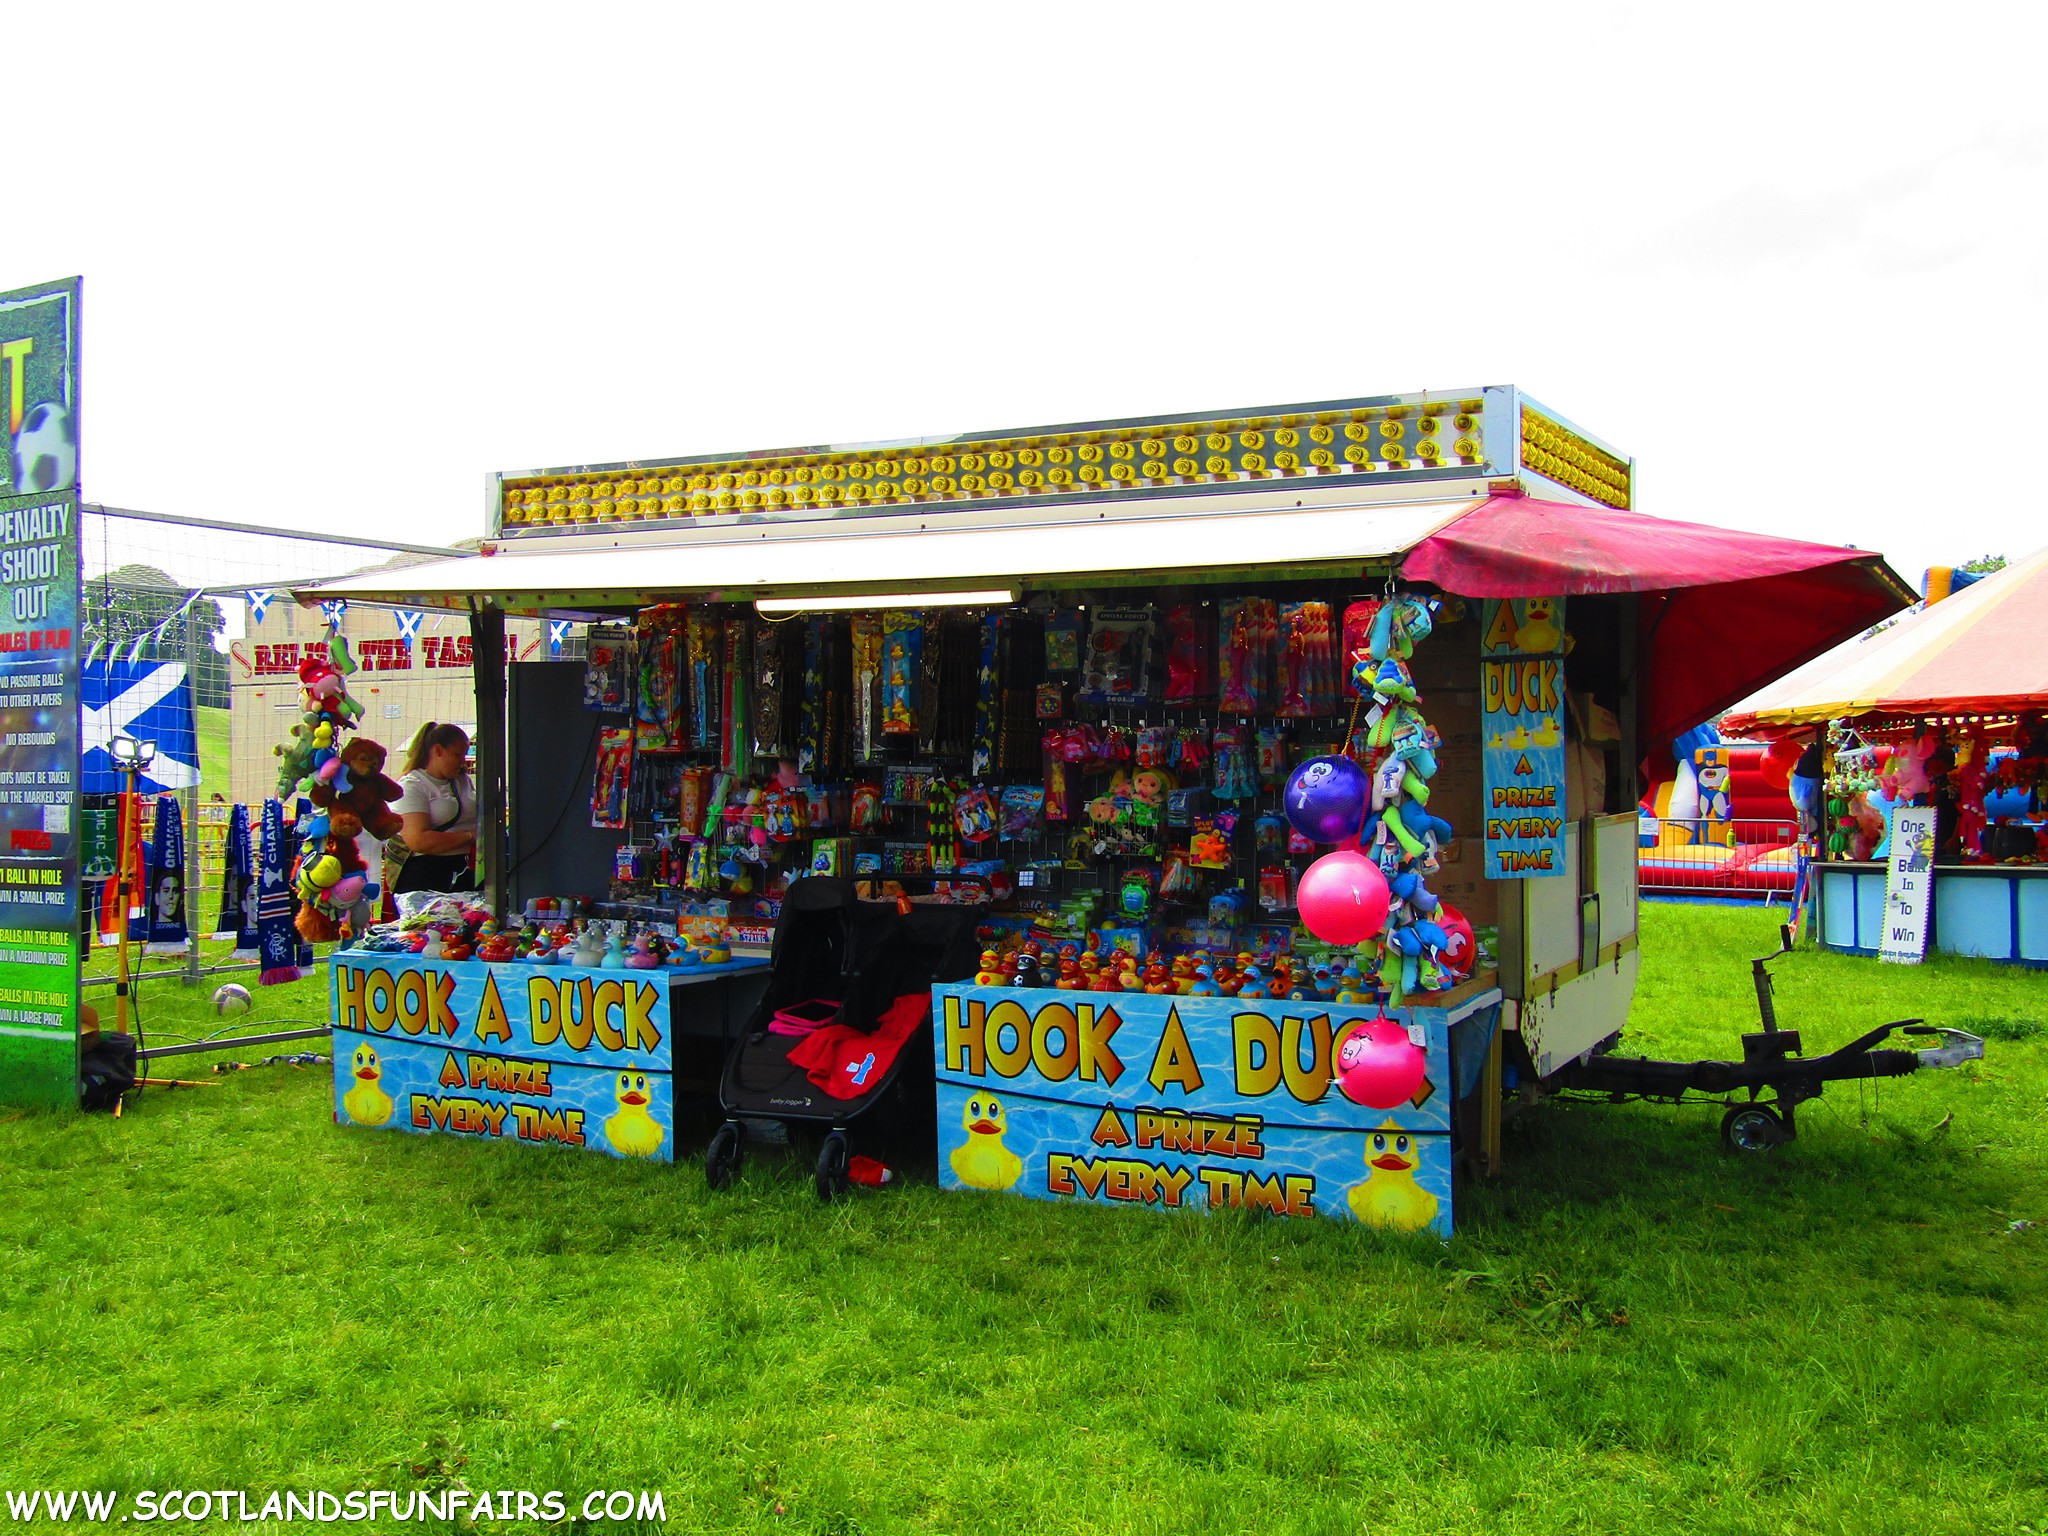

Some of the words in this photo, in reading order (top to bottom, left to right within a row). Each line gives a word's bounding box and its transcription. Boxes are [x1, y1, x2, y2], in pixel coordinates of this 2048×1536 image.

[2, 544, 62, 584] SHOOT
[14, 585, 50, 620] OUT
[1483, 598, 1520, 653] A
[0, 631, 27, 652] ULES
[358, 638, 412, 671] THE
[10, 674, 41, 688] PASSING
[42, 673, 64, 687] BALLS
[1485, 661, 1559, 716] DUCK
[0, 694, 9, 708] TO
[10, 694, 32, 708] OTHER
[32, 693, 63, 706] PLAYERS
[6, 733, 17, 746] NO
[18, 732, 56, 746] REBOUNDS
[1513, 754, 1533, 775] A
[0, 771, 14, 784] OTS
[15, 771, 36, 784] MUST
[37, 771, 47, 784] BE
[48, 771, 70, 784] TAKEN
[10, 791, 23, 804] THE
[24, 791, 54, 804] MARKED
[55, 791, 74, 804] SPOT
[1492, 785, 1556, 808] PRIZE
[1487, 817, 1562, 840] EVERY
[1901, 819, 1926, 833] One
[1497, 849, 1553, 872] TIME
[6, 868, 27, 885] BALL
[29, 868, 40, 885] IN
[41, 869, 62, 886] HOLE
[1902, 878, 1914, 890] In
[13, 890, 19, 903] A
[20, 890, 44, 904] SMALL
[45, 891, 65, 905] PRIZE
[1900, 902, 1912, 915] To
[0, 928, 22, 944] BALLS
[23, 929, 33, 945] IN
[34, 931, 49, 946] THE
[50, 931, 69, 946] HOLE
[1892, 927, 1915, 942] Win
[0, 949, 9, 962] IN
[10, 950, 16, 963] A
[16, 951, 48, 965] MEDIUM
[48, 952, 68, 966] PRIZE
[0, 987, 21, 1003] BALLS
[23, 989, 34, 1005] IN
[34, 990, 49, 1006] THE
[50, 992, 69, 1007] HOLE
[14, 1009, 20, 1023] A
[20, 1010, 42, 1025] LARGE
[43, 1012, 63, 1027] PRIZE
[336, 964, 460, 1039] HOOK
[475, 968, 513, 1044] A
[527, 975, 663, 1054] DUCK
[943, 996, 1126, 1088] HOOK
[1148, 1001, 1205, 1096] A
[1231, 1011, 1436, 1110] DU
[438, 1051, 465, 1090] A
[467, 1052, 552, 1097] PRIZE
[409, 1094, 508, 1137] EVERY
[511, 1104, 585, 1147] TIME
[1091, 1101, 1131, 1149] A
[1135, 1106, 1265, 1160] PRIZE
[1047, 1153, 1194, 1208] EVERY
[1198, 1167, 1316, 1219] TIME
